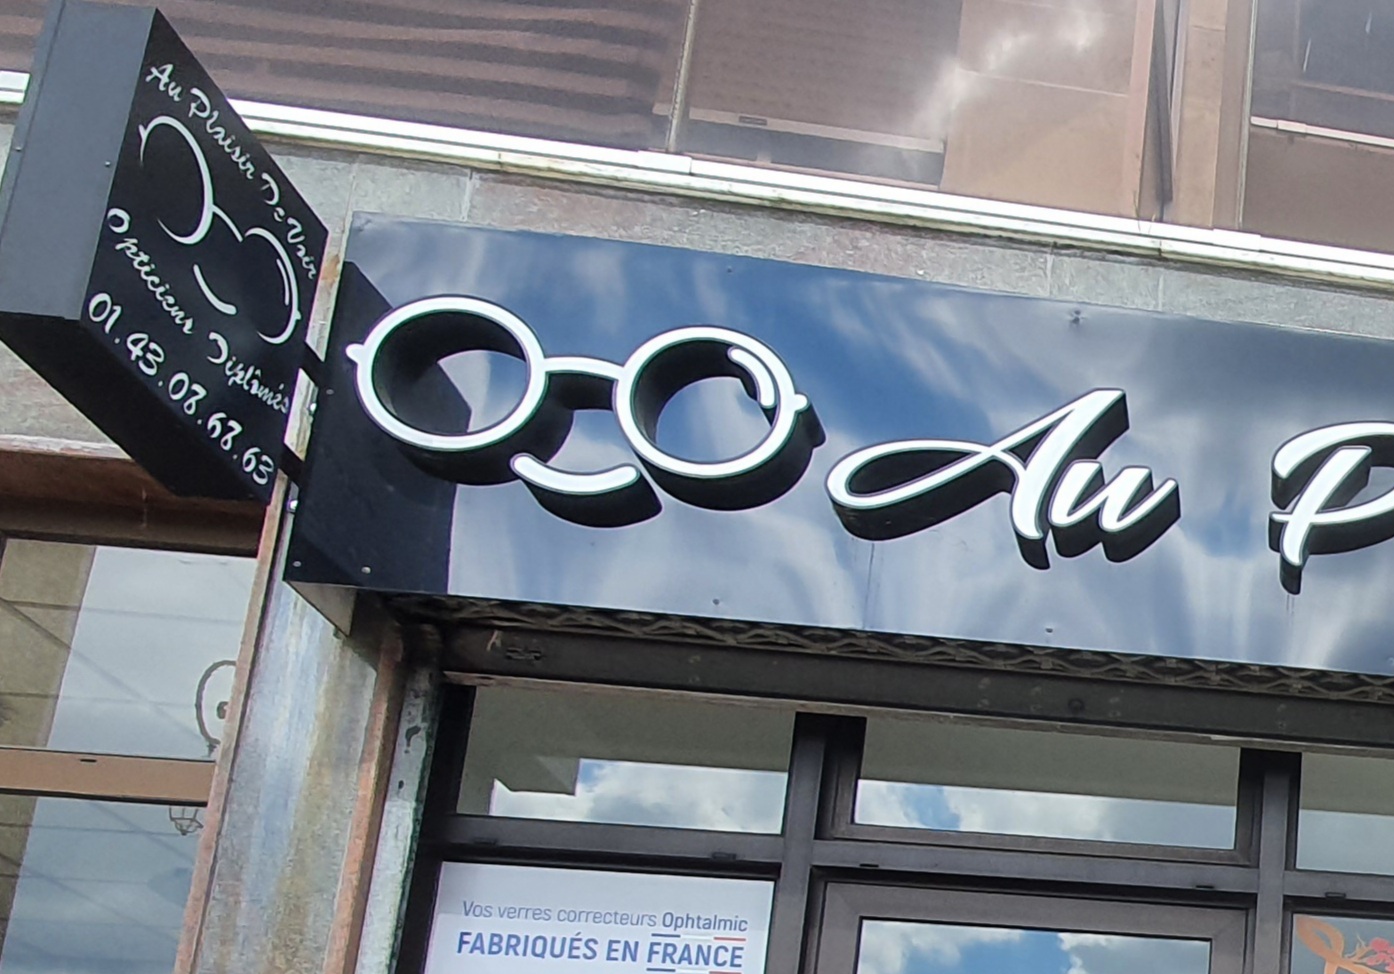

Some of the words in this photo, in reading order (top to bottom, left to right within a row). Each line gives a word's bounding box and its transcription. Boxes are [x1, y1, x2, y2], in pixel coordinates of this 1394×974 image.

[146, 64, 182, 101] Au
[188, 88, 256, 179] Plaisir
[260, 173, 284, 222] De
[287, 216, 318, 279] Voir
[107, 208, 194, 334] Opticiens
[827, 387, 1180, 545] Au
[456, 931, 599, 960] FABRIQUÉS
[606, 939, 639, 962] EN
[646, 942, 744, 968] FRANCE
[463, 900, 493, 918] Vos
[498, 905, 552, 921] verres
[557, 908, 657, 927] correcteurs
[662, 912, 748, 932] Ophtalmic
